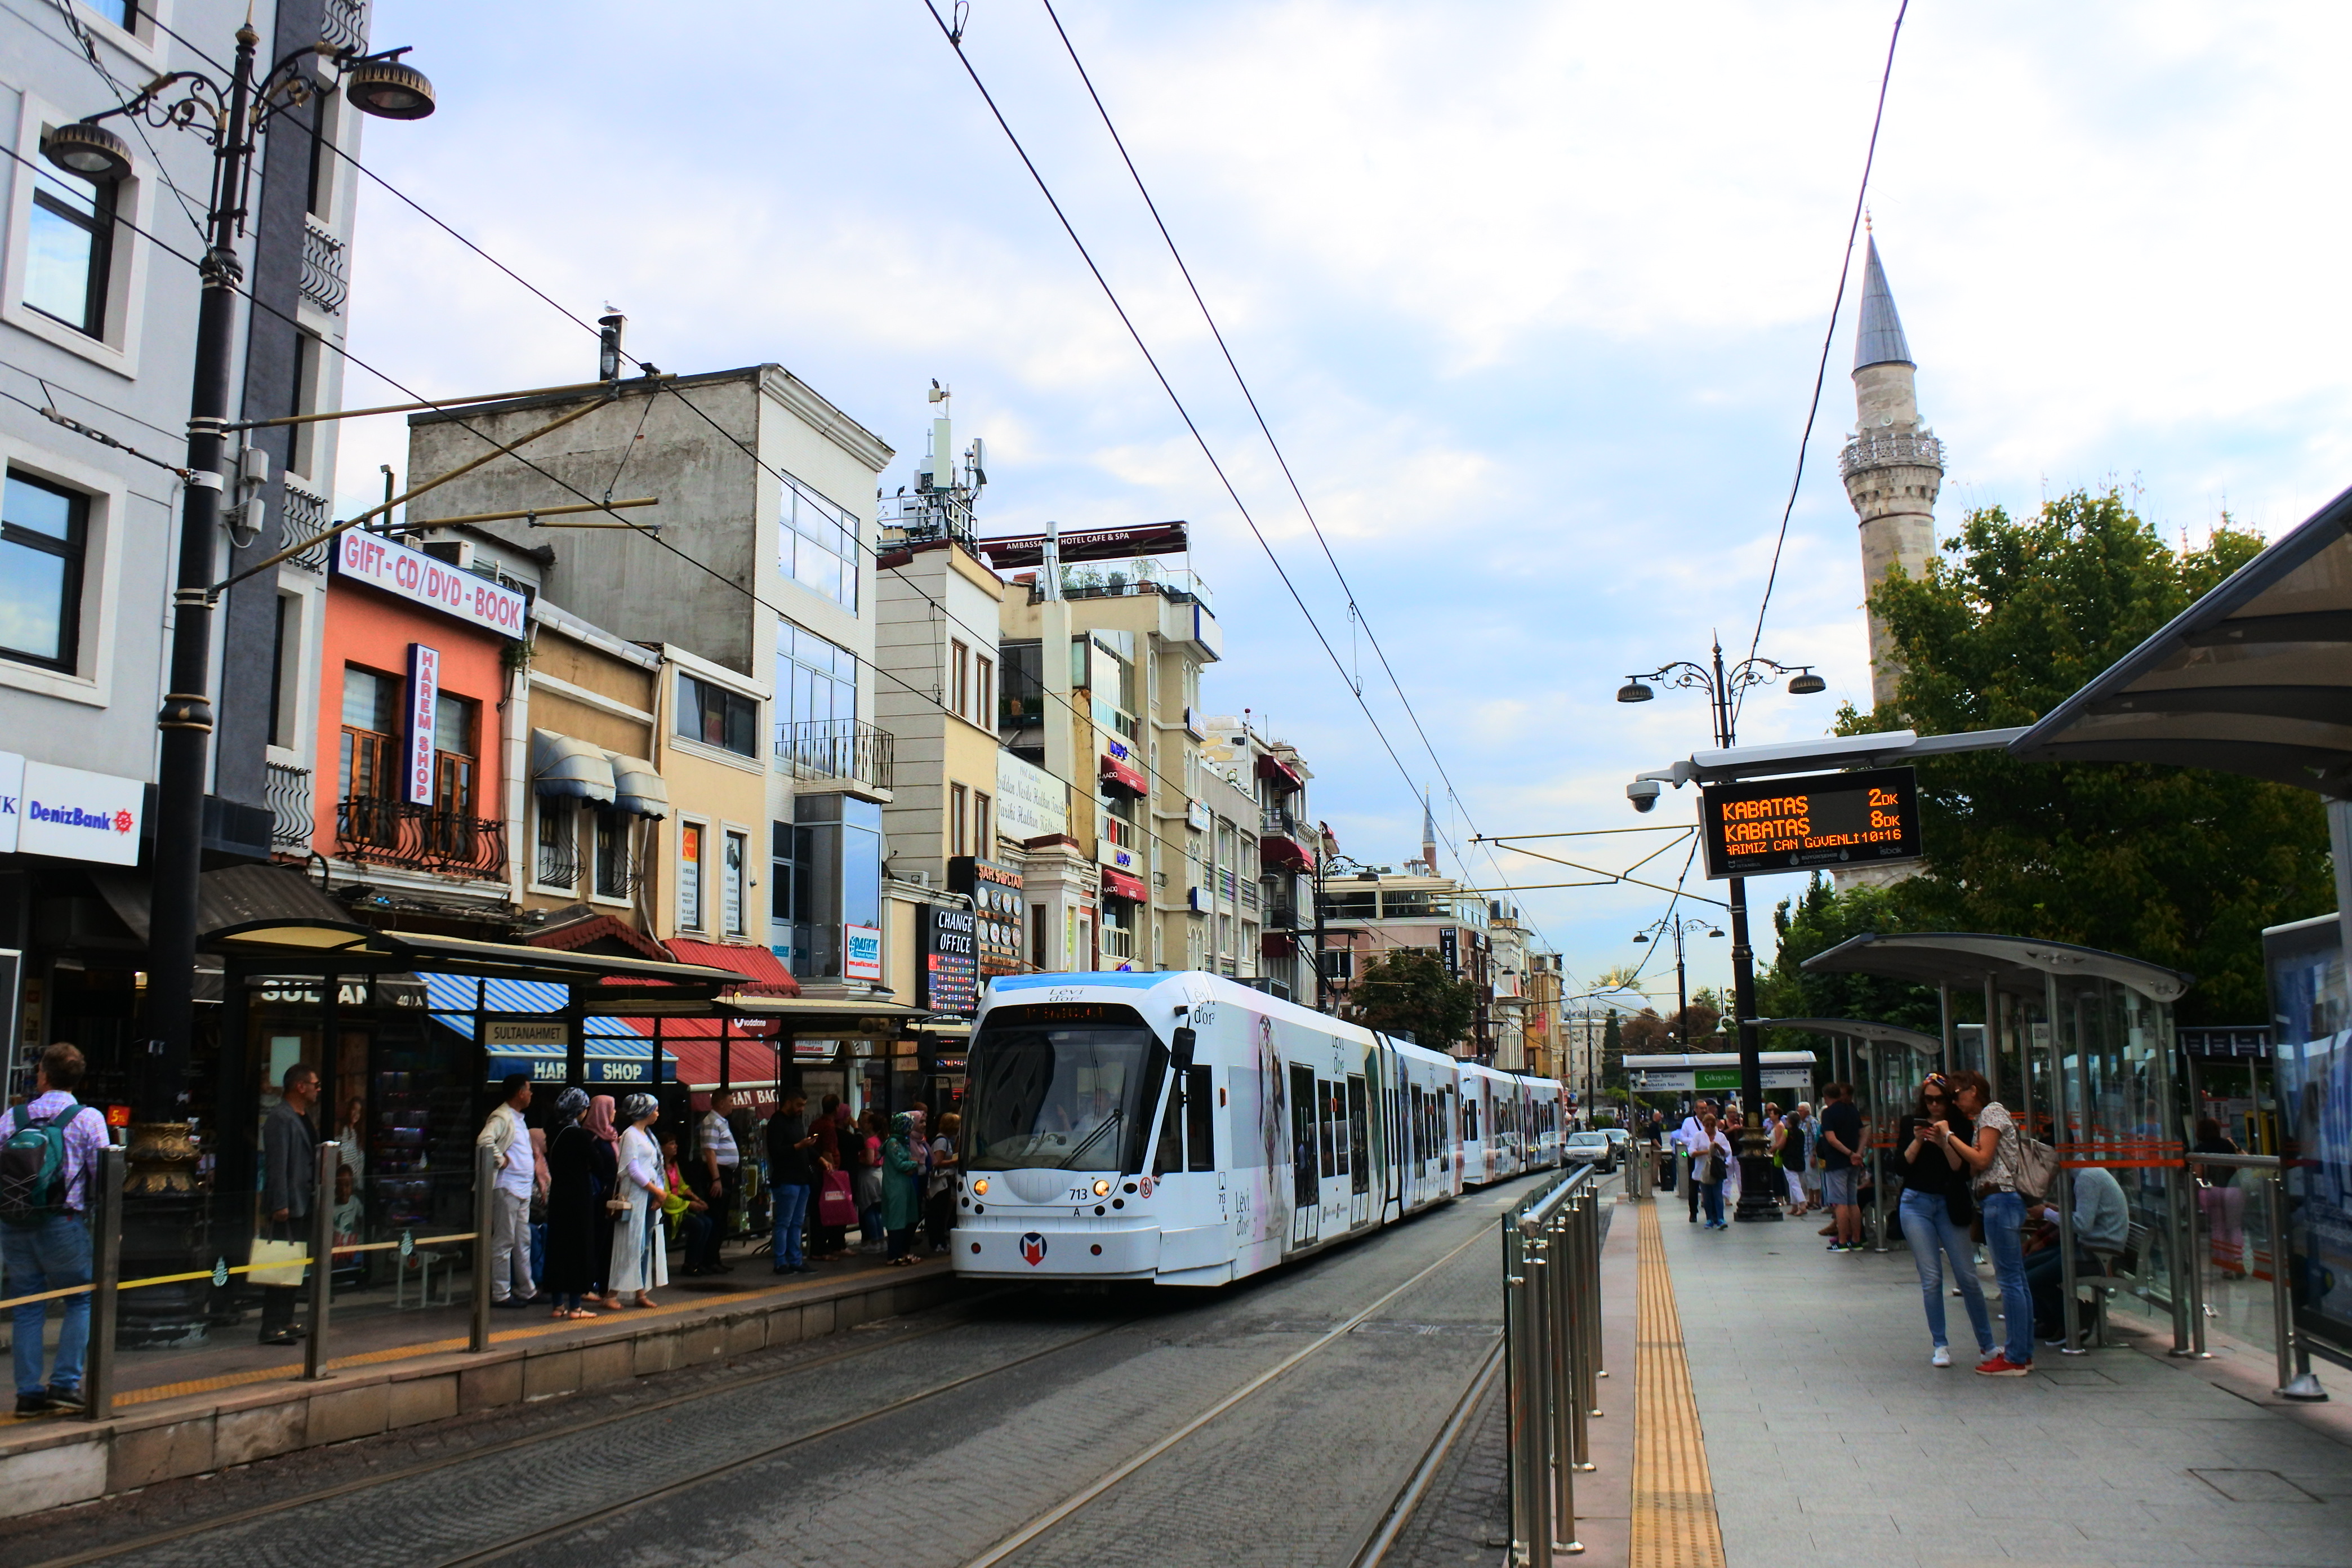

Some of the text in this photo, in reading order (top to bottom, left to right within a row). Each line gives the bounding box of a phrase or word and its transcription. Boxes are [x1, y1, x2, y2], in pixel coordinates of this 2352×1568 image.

[1006, 540, 1045, 550] AMBASSA
[1061, 537, 1085, 545] HOTEL
[1087, 534, 1106, 543] CAFE
[345, 534, 385, 577] GIFT
[396, 555, 462, 607] CD/DVD
[475, 586, 521, 630] BOOK
[416, 651, 434, 800] HAREM SHOP
[997, 774, 1066, 818] esilden Nesile Halkın Tercihi
[30, 800, 111, 831] DenizBank
[997, 798, 1015, 821] Tarihi
[1017, 805, 1039, 829] Halkın
[1722, 796, 1808, 821] KABATAŞ
[1725, 817, 1810, 843] KABATAŞ
[1774, 838, 1798, 852] CAN
[1861, 829, 1902, 844] 10:16
[1879, 846, 1902, 856] isbak
[938, 911, 973, 933] CHANGE
[940, 933, 972, 954] OFFICE
[261, 980, 367, 1005] SULAN
[494, 1026, 561, 1040] SULTANAHMET
[743, 1018, 767, 1027] vodafone
[533, 1062, 642, 1080] HARM SHOP
[938, 1076, 965, 1085] SULTAAHMET
[1070, 1188, 1088, 1201] 713
[1073, 1207, 1080, 1217] A
